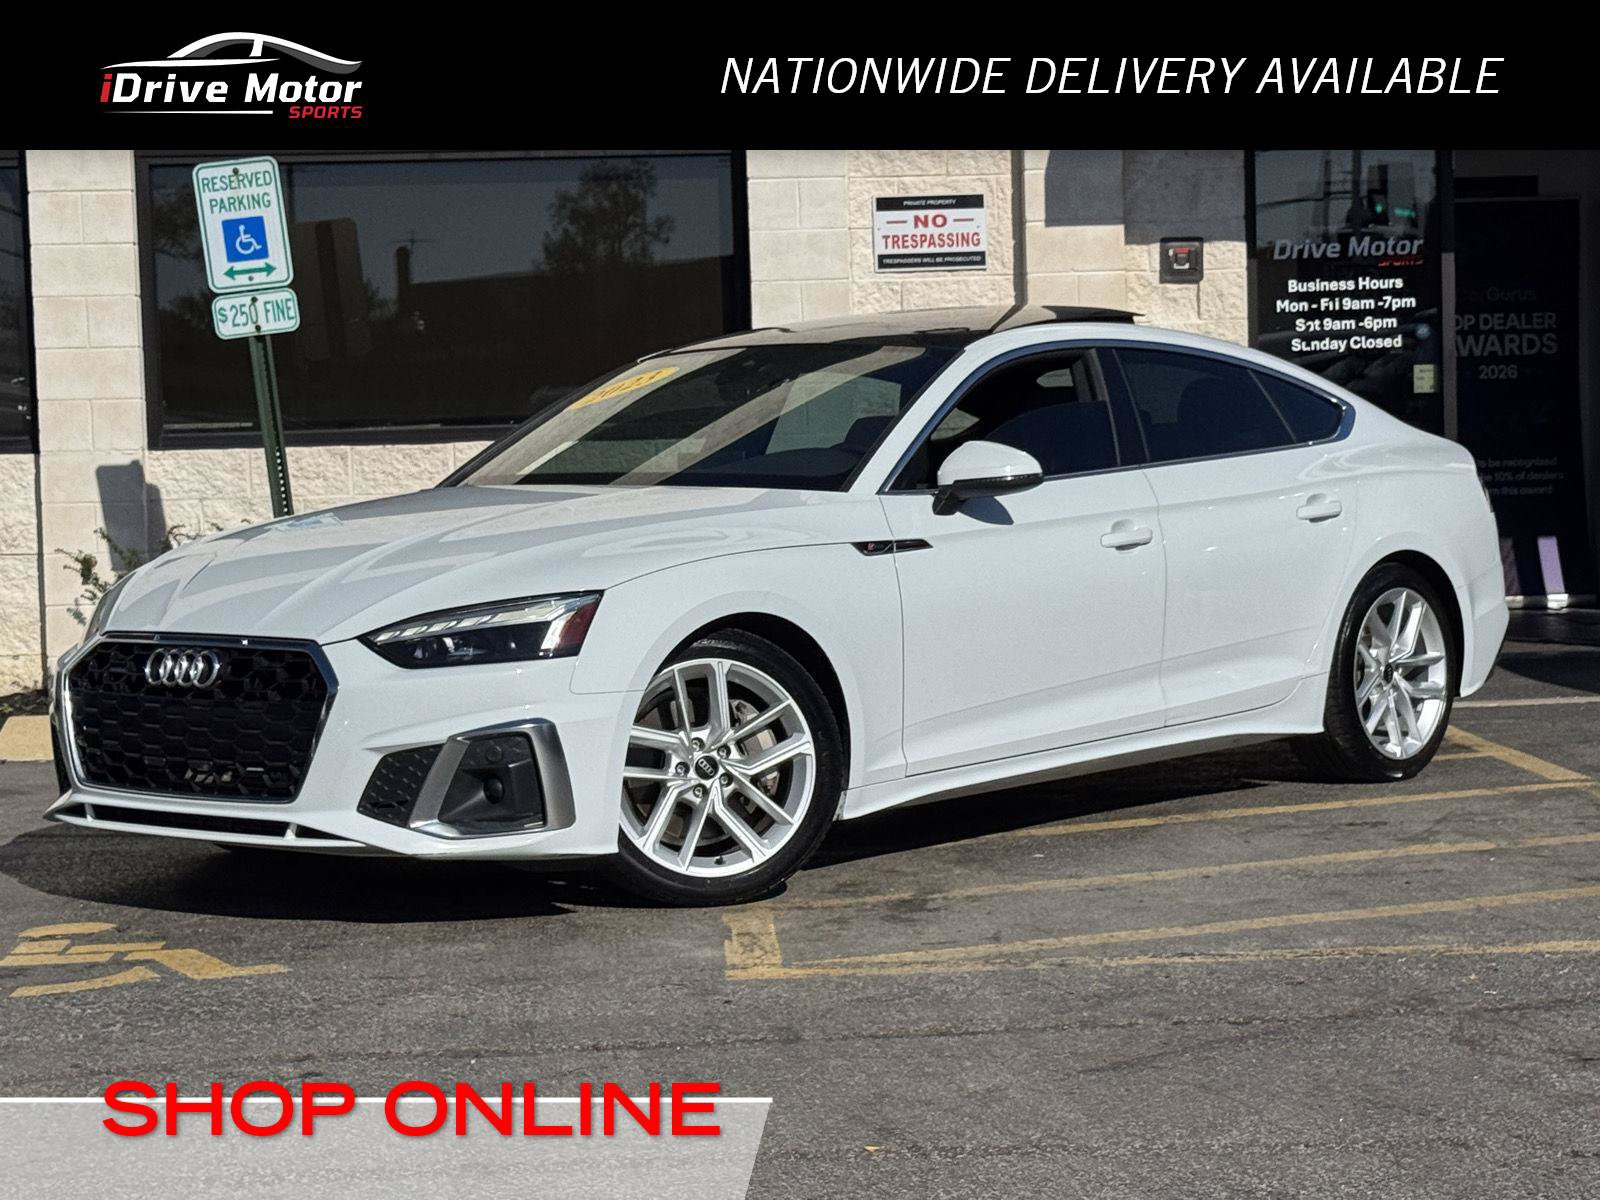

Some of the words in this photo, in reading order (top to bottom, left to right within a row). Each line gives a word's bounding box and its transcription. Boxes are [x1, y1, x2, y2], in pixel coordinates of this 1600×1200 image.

[201, 170, 273, 193] RESERVED
[209, 192, 271, 214] PARKING
[913, 214, 948, 229] NO
[881, 232, 981, 250] TRESPASSING
[1348, 236, 1424, 258] Motor
[882, 257, 922, 265] TRESPASSERS
[944, 255, 982, 263] PROSECUTED
[1287, 277, 1355, 293] Business
[1358, 276, 1404, 290] Hours
[217, 302, 258, 328] $250
[264, 298, 295, 323] FINE
[1276, 299, 1308, 313] Mon
[1342, 297, 1375, 311] 9am
[1323, 317, 1356, 331] 9am
[1455, 314, 1476, 331] OP
[1479, 312, 1557, 331] DEALER
[1350, 334, 1402, 349] Closed
[1456, 333, 1559, 357] WARDS
[1478, 364, 1518, 380] 2026
